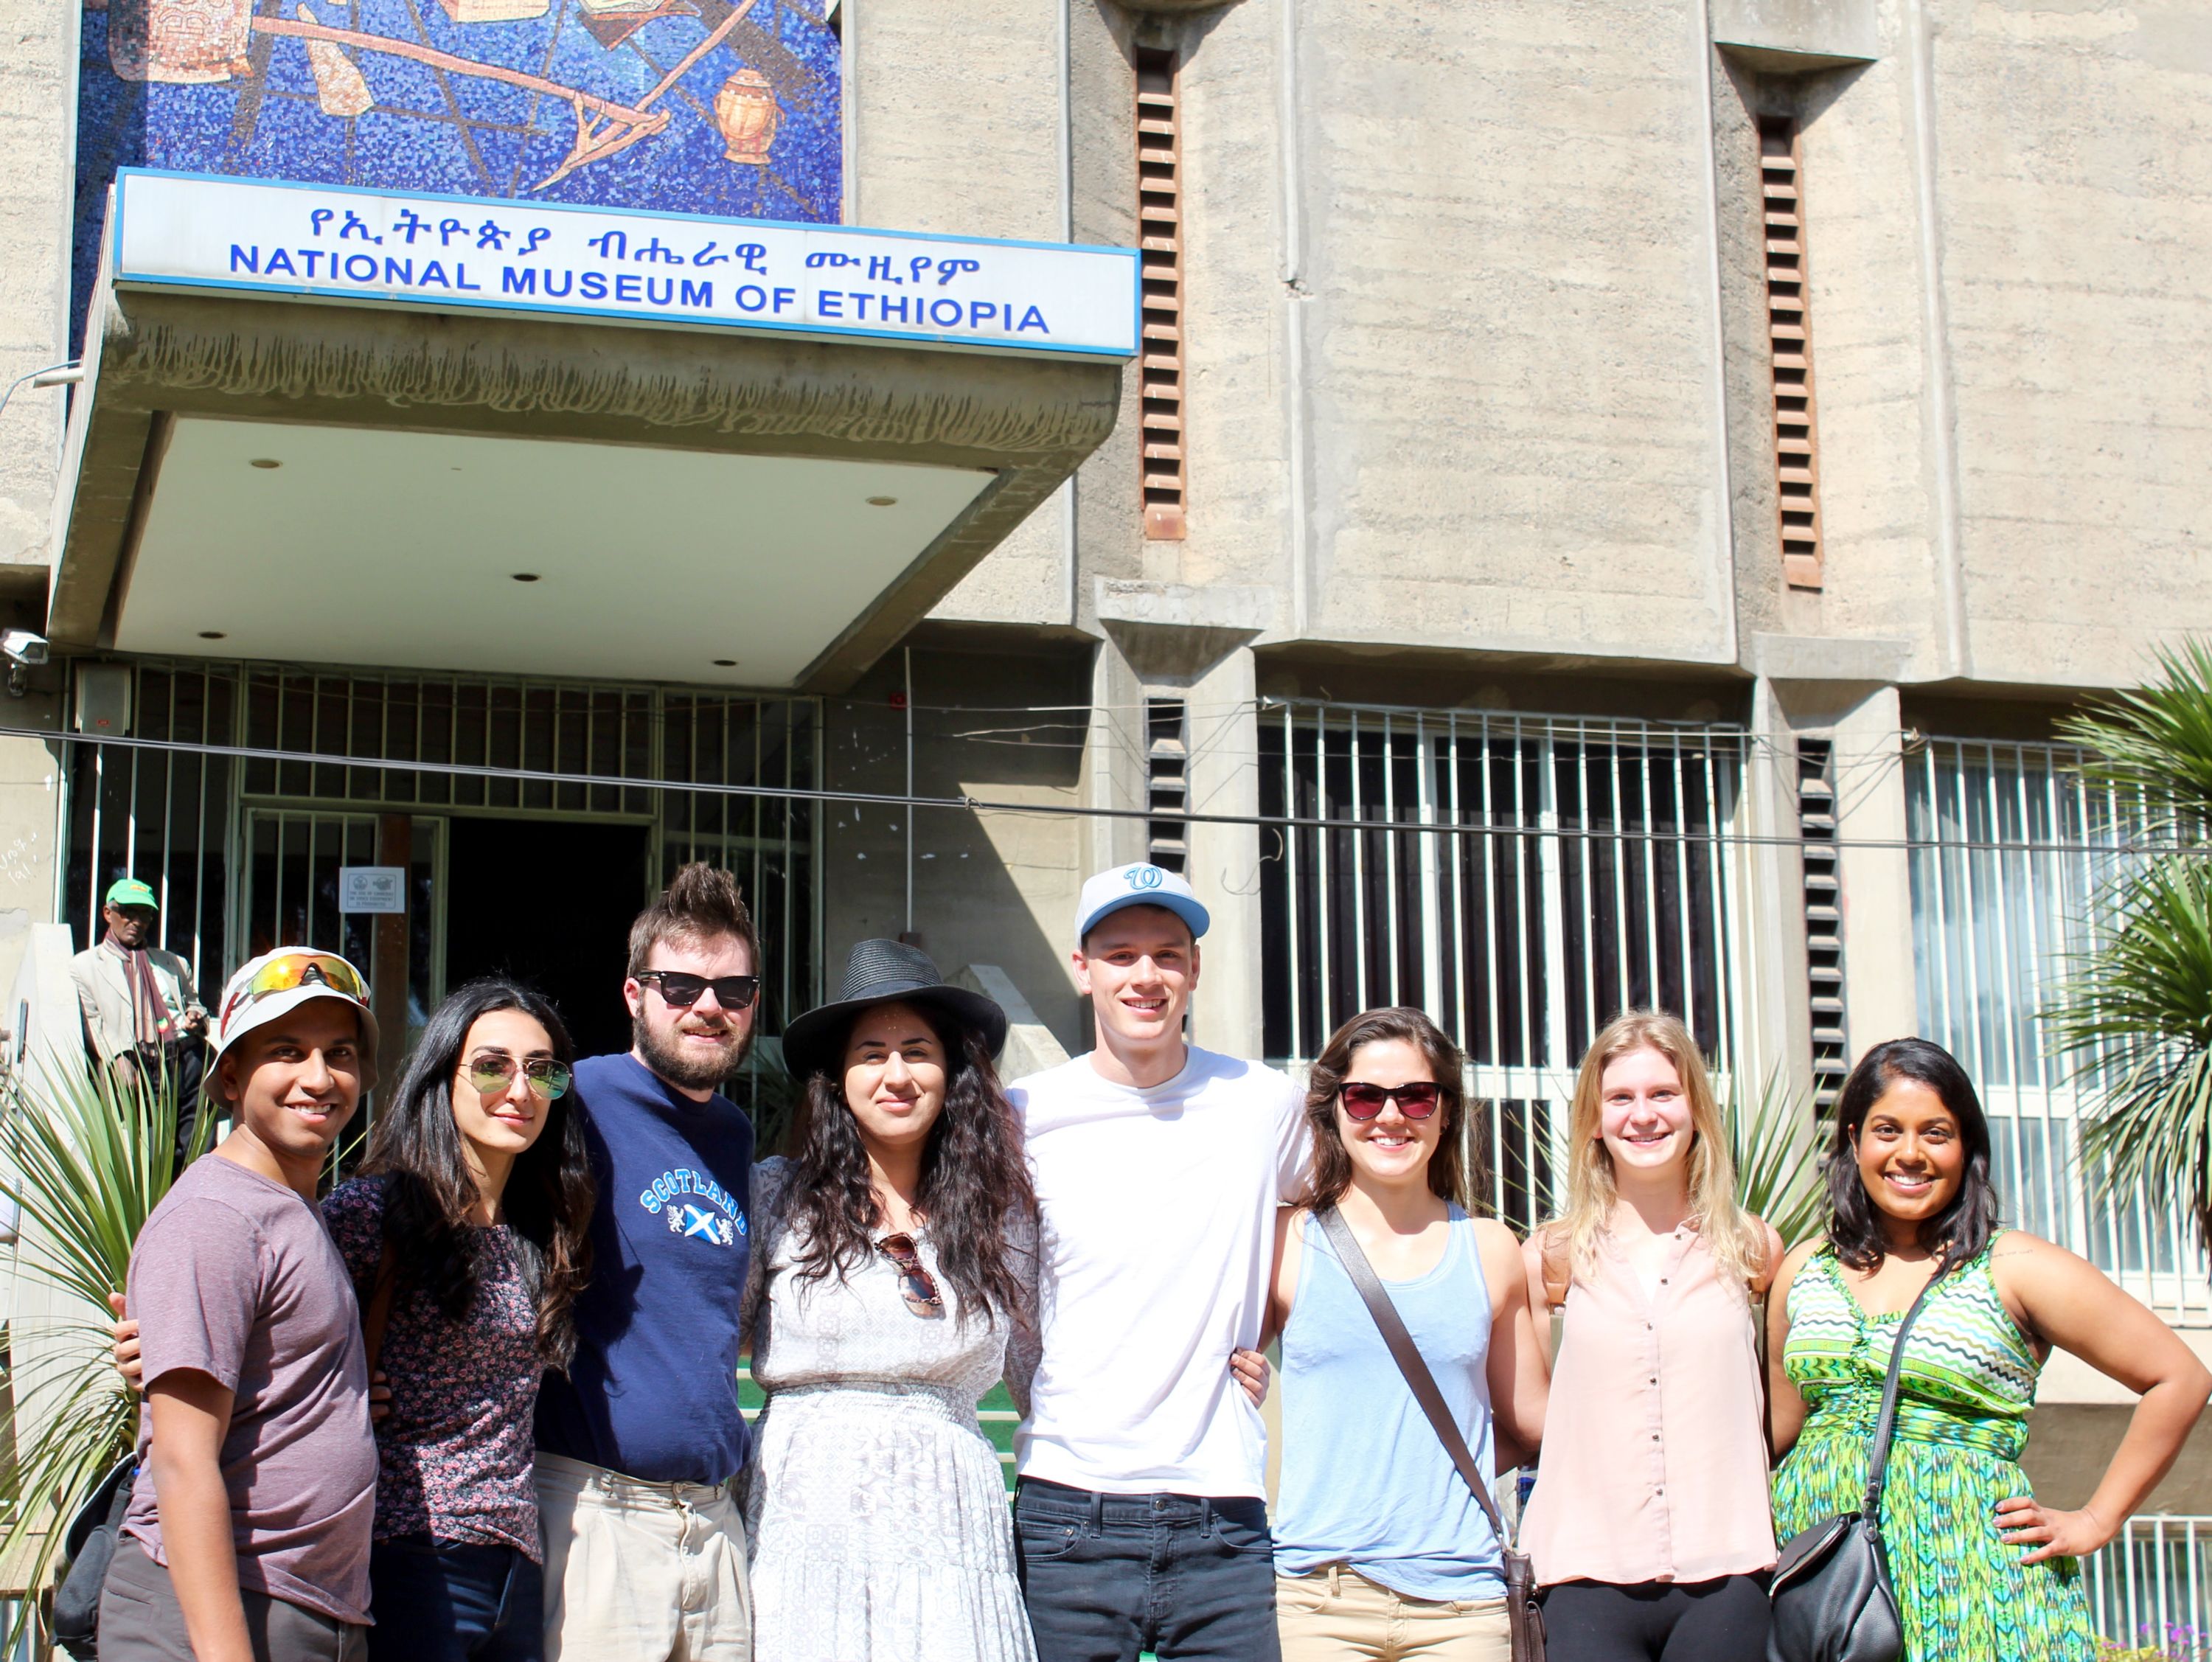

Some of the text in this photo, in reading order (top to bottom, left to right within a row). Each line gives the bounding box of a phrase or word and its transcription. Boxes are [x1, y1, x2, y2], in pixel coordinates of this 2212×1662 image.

[311, 209, 980, 285] የኢትዮጵያ ብሔራዊ ሙዚየም
[231, 244, 1050, 334] NATIONAL MUSEUM OF ETHIOPIA
[1123, 866, 1164, 890] W
[639, 1168, 748, 1237] SCOTLAND
